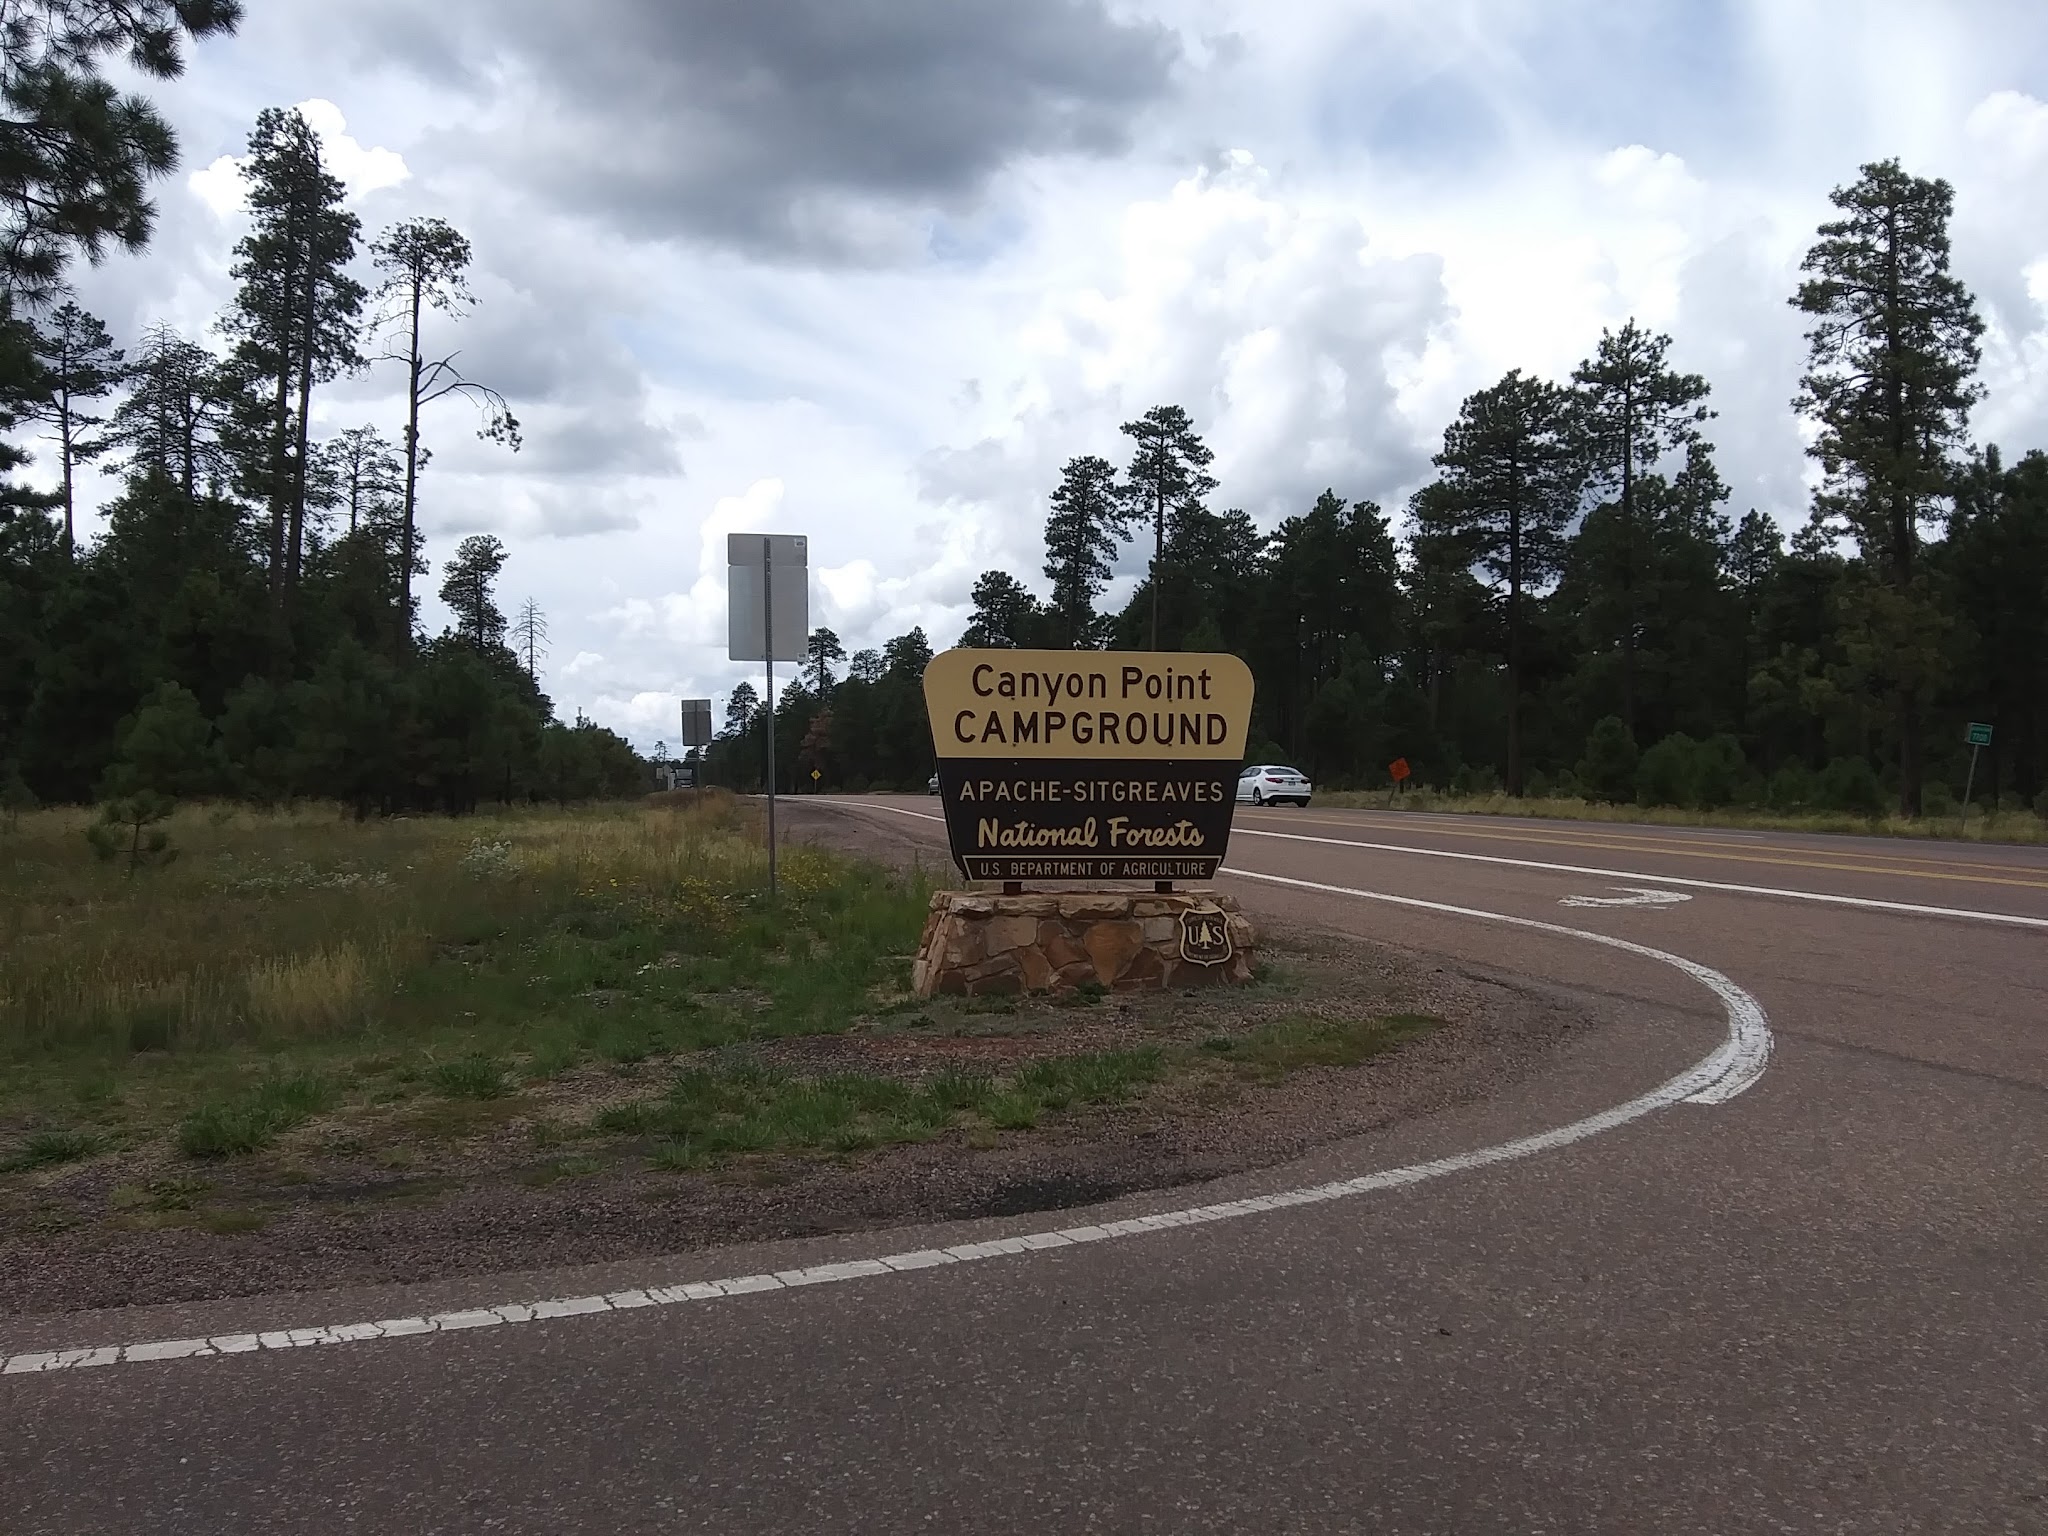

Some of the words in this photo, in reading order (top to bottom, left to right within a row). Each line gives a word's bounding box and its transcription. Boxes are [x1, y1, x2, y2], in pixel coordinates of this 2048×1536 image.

[972, 664, 1106, 707] Canyon
[1121, 666, 1211, 700] Point
[955, 710, 1227, 745] CAMPGROUND
[960, 781, 1223, 802] APACHE-SITGREAVES
[978, 817, 1098, 848] National
[1107, 816, 1204, 847] Forests
[980, 862, 1003, 875] U.S.
[1011, 862, 1093, 876] DEPARTMENT
[1100, 862, 1116, 876] OF
[1123, 862, 1206, 876] AGRICULTURE
